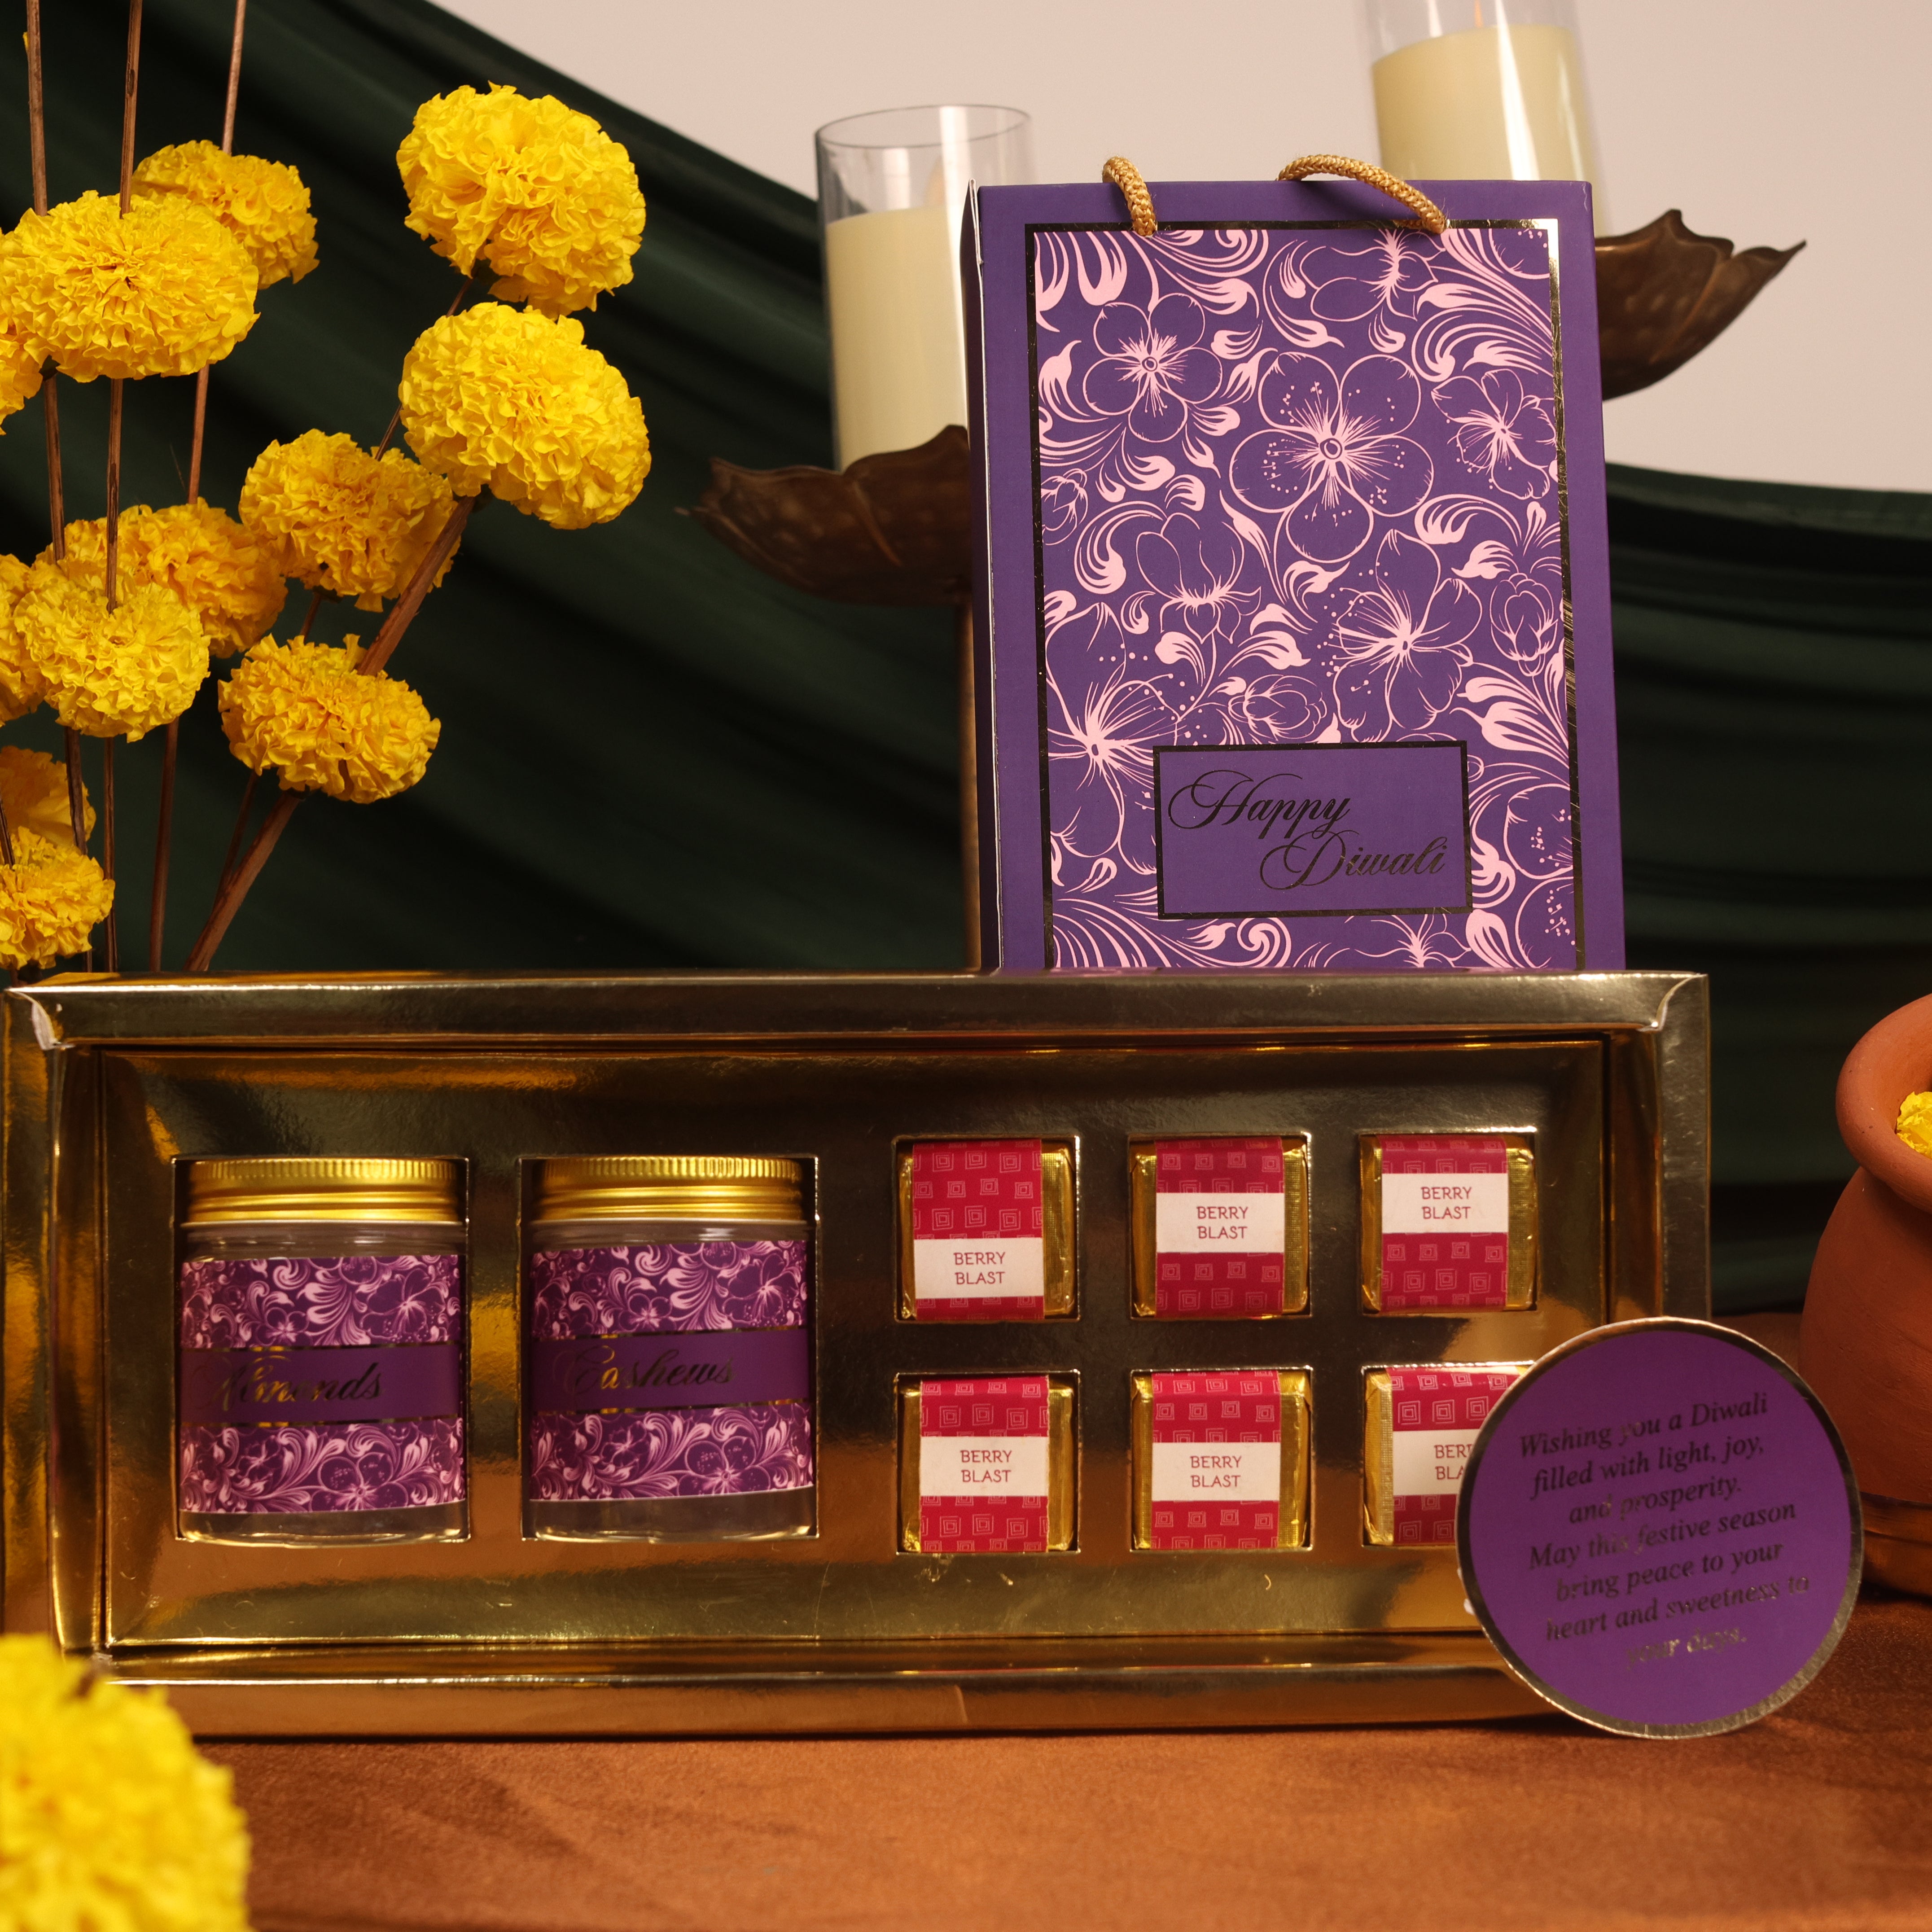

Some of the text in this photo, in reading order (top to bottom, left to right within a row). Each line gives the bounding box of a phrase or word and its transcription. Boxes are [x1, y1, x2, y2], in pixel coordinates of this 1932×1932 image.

[1168, 769, 1350, 840] Happy
[1259, 830, 1448, 890] Diwali
[1421, 1187, 1472, 1200] BERRY
[1196, 1206, 1248, 1219] BERRY
[1422, 1206, 1471, 1219] BLAST
[1197, 1226, 1247, 1239] BLAST
[953, 1252, 1005, 1265] BERRY
[955, 1271, 1005, 1285] BLAST
[552, 1345, 735, 1395] Cashews
[1519, 1392, 1768, 1458] Wishing you a Diwali
[960, 1450, 1012, 1463] BERRY
[1434, 1444, 1472, 1459] BER
[1190, 1456, 1241, 1468] BERRY
[1529, 1435, 1764, 1501] filled with light, joy,
[961, 1469, 1011, 1483] BLAST
[1191, 1475, 1240, 1487] BLAST
[1568, 1475, 1742, 1524] and prosperity.
[1528, 1503, 1797, 1570] May this festive season
[1555, 1542, 1784, 1602] bring peace to your
[1546, 1574, 1810, 1641] heart and sweetness to
[1625, 1638, 1682, 1671] your
